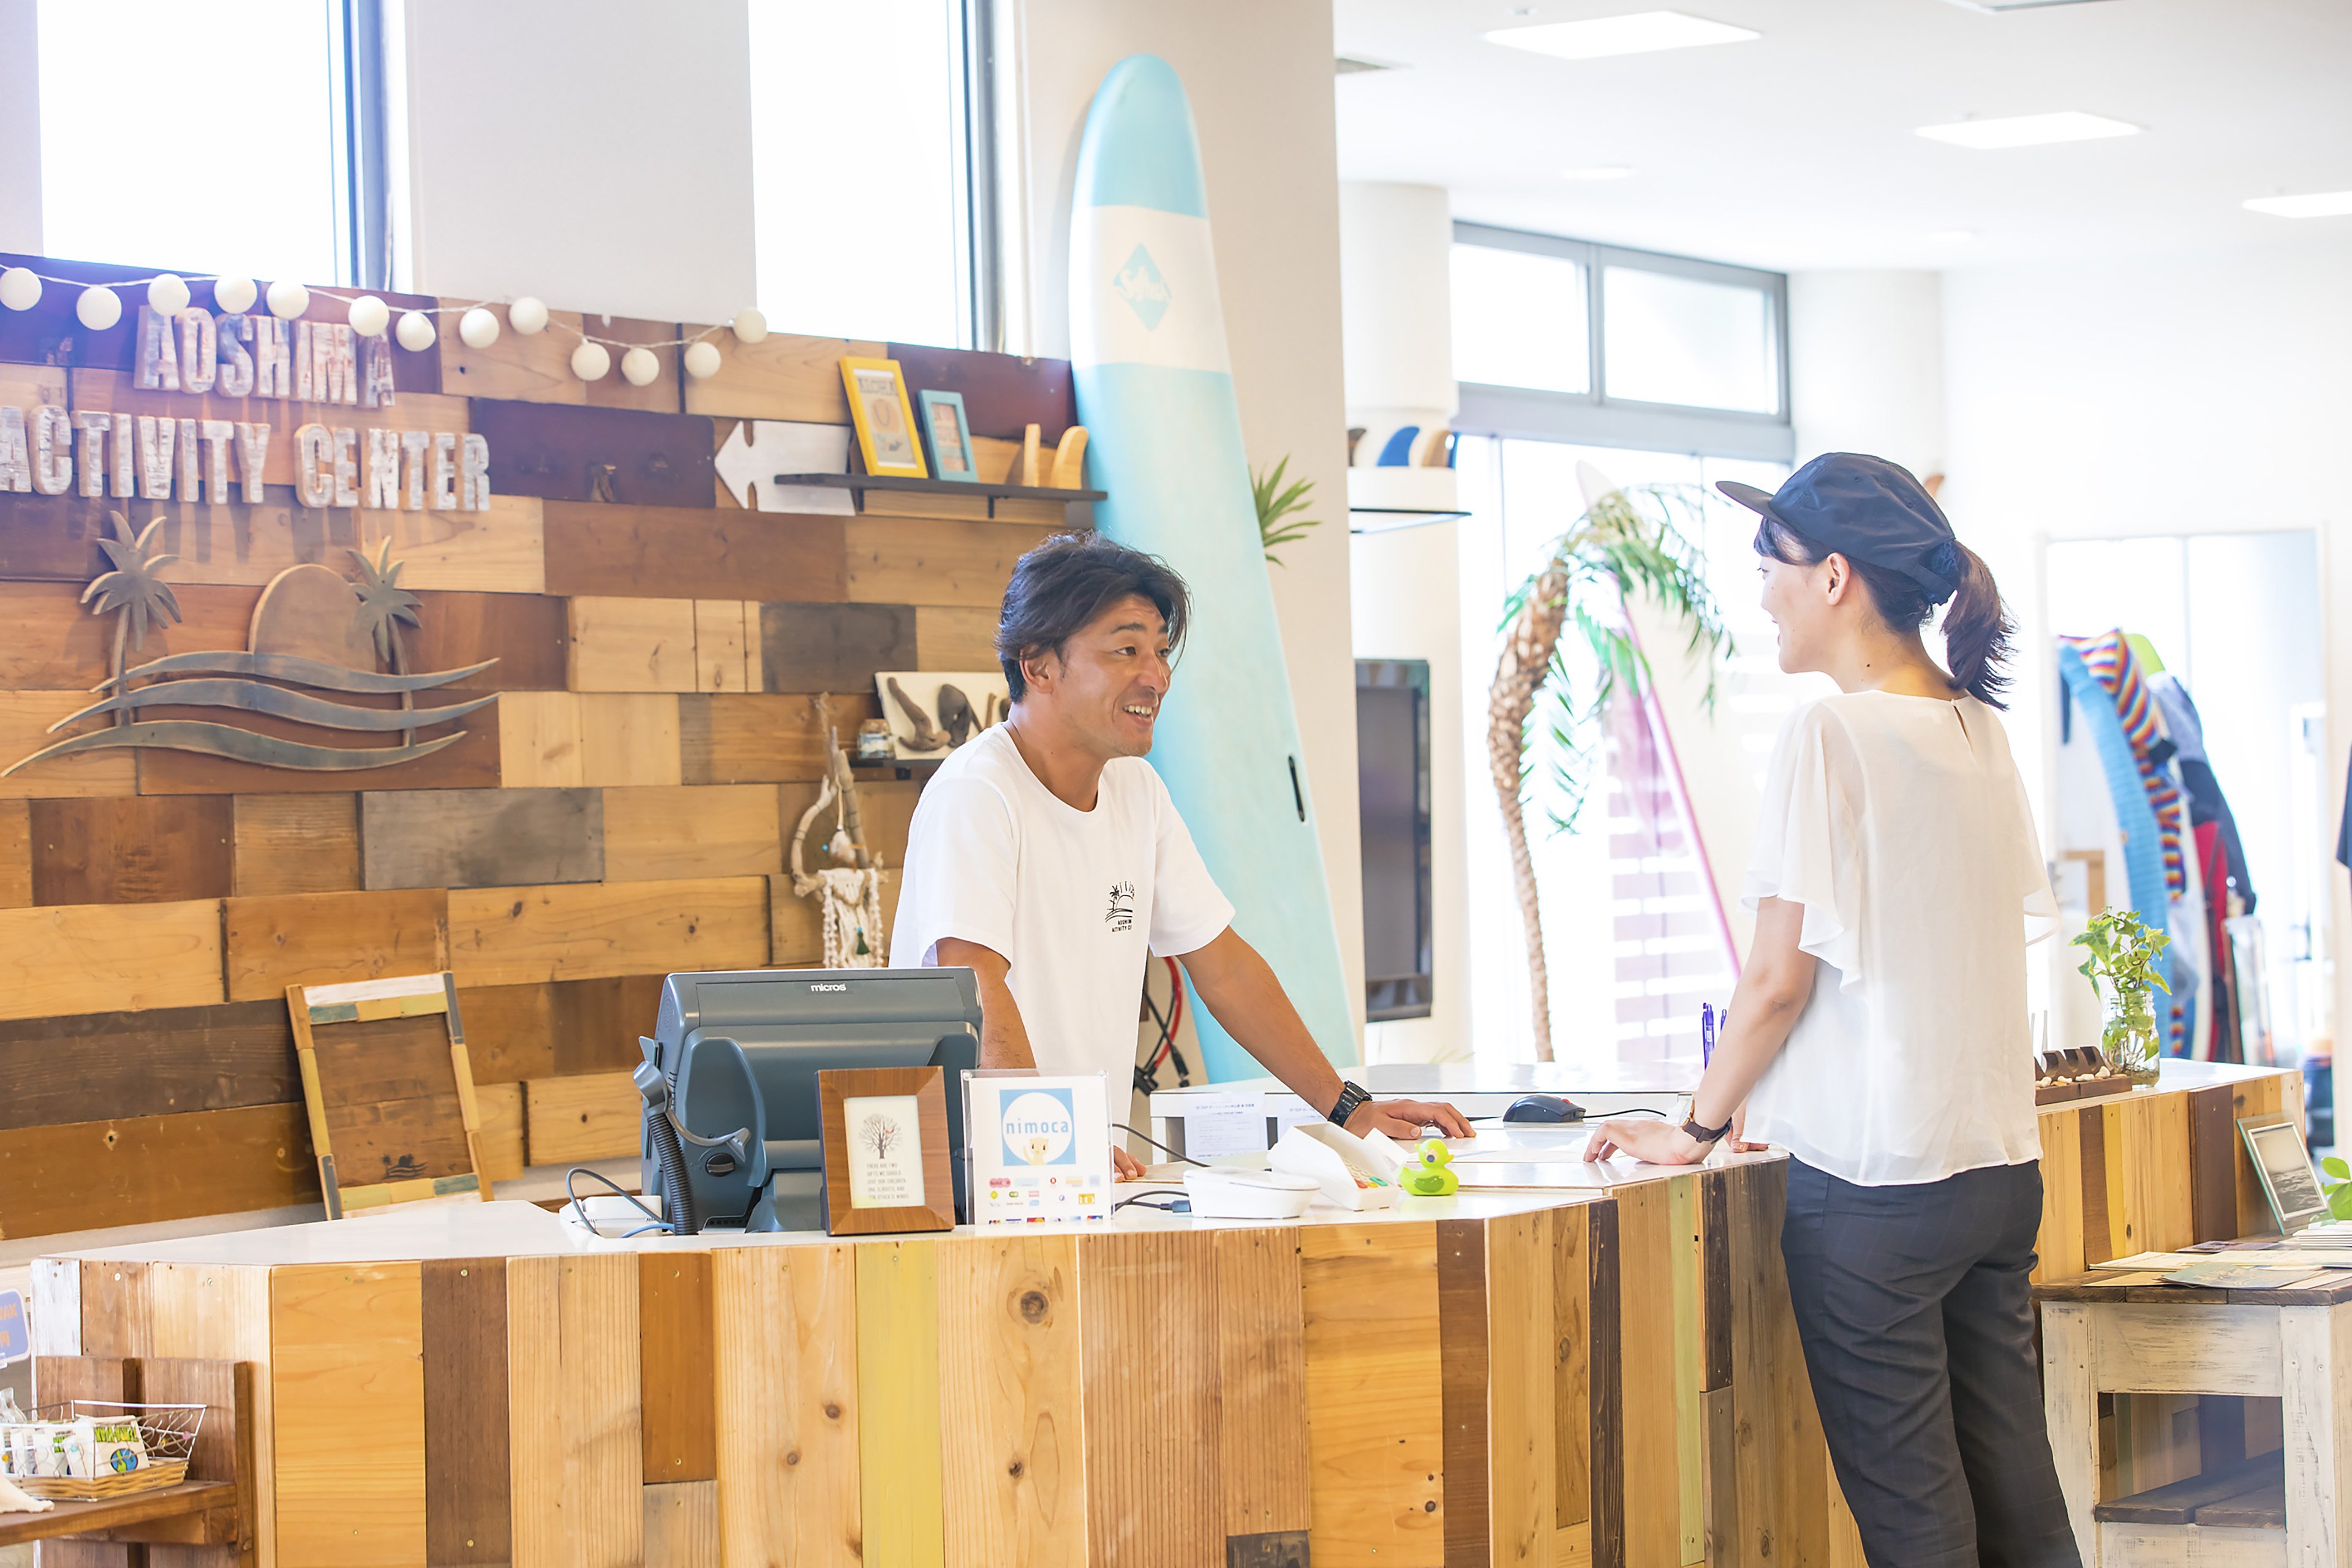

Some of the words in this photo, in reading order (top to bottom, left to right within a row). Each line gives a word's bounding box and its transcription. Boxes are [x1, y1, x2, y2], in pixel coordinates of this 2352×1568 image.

[134, 305, 395, 409] AOSHIMA
[0, 405, 271, 504] ACTIVITY
[294, 423, 490, 511] CENTER
[810, 983, 846, 992] micros
[1006, 1118, 1069, 1134] nimoca
